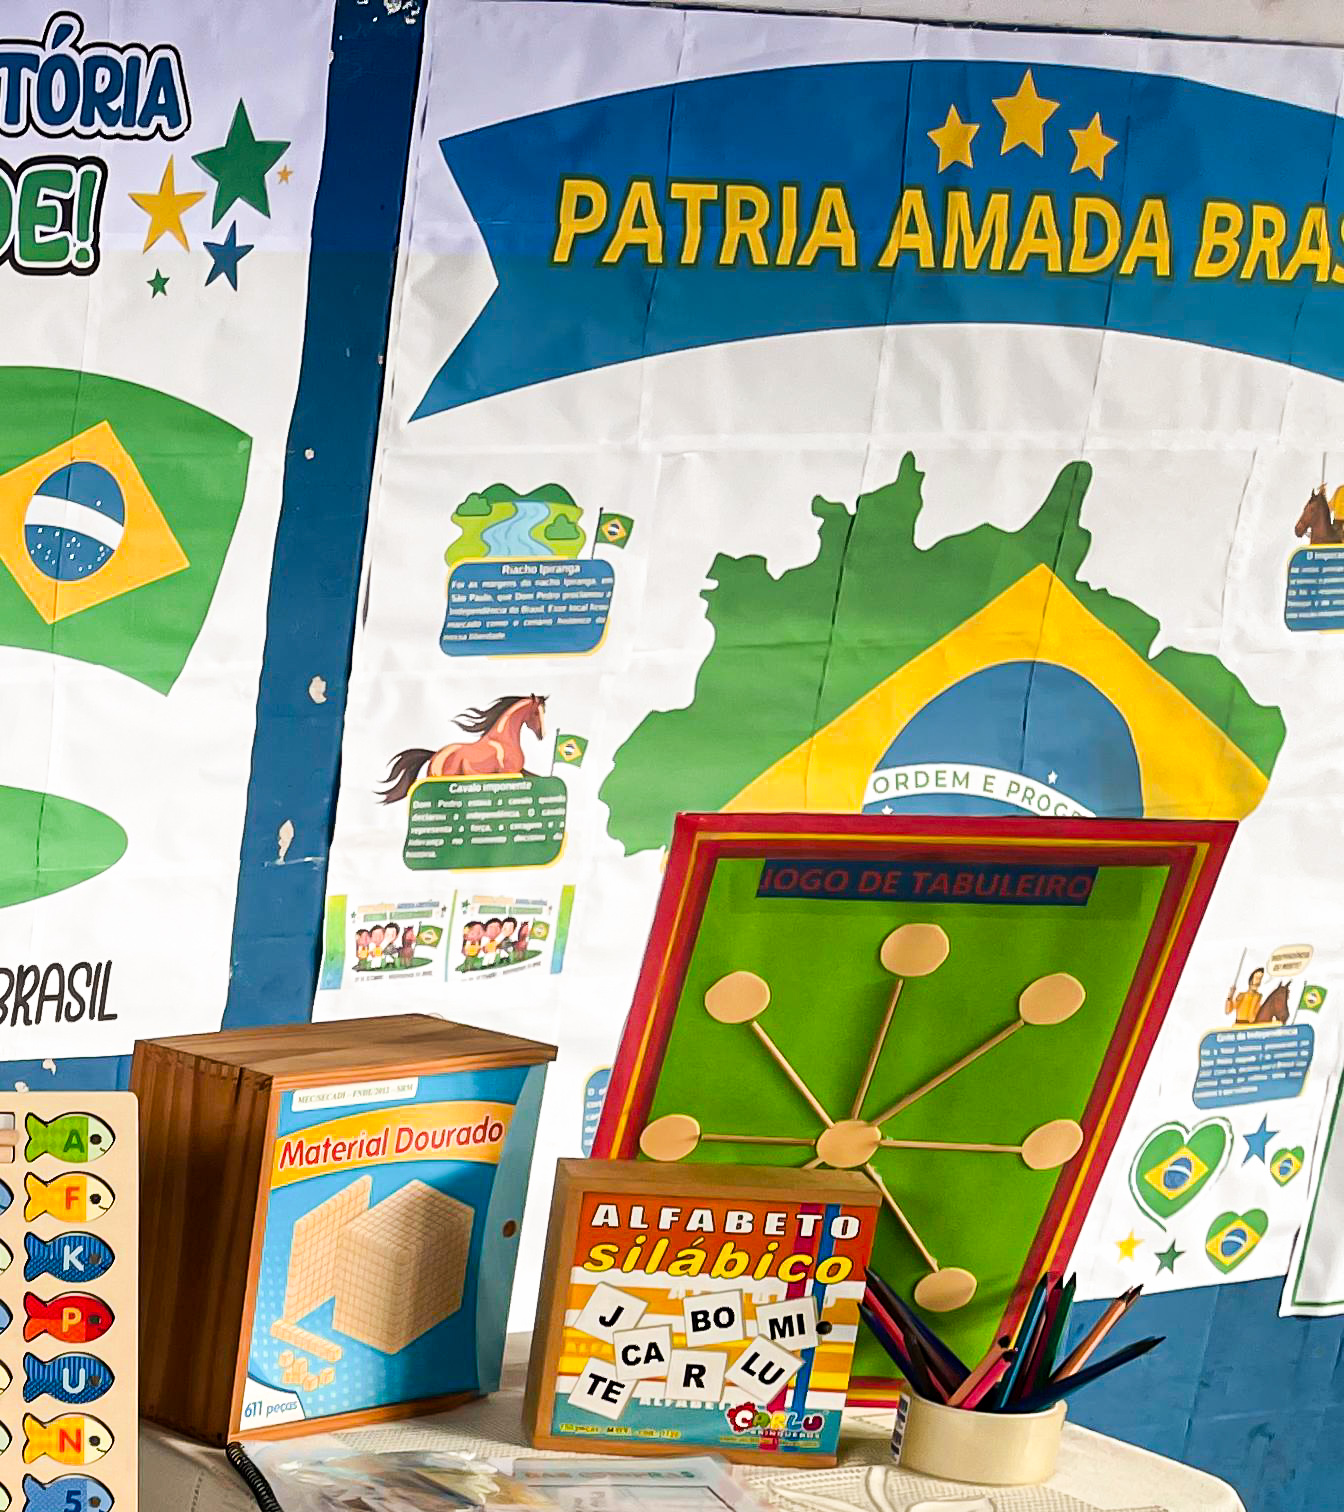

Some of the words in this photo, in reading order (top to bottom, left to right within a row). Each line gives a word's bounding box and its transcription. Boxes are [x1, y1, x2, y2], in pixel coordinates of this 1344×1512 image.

[551, 177, 857, 268] PATRIA
[875, 188, 1172, 279] AMADA
[873, 770, 970, 794] ORDEM
[983, 774, 994, 792] E
[763, 867, 850, 894] JOGO
[858, 870, 902, 894] DE
[912, 870, 1093, 899] TABULEIRO
[63, 1129, 86, 1153] A
[279, 1128, 390, 1171] Material
[394, 1115, 504, 1154] Dourado
[65, 1188, 80, 1211] F
[591, 1204, 860, 1240] ALFABETO
[63, 1246, 84, 1271] K
[583, 1235, 854, 1285] silábico
[62, 1307, 80, 1332] P
[599, 1305, 624, 1328] J
[690, 1307, 735, 1332] BO
[769, 1314, 806, 1340] MI
[621, 1341, 664, 1366] CA
[63, 1367, 84, 1392] U
[682, 1363, 706, 1389] R
[741, 1352, 785, 1385] LU
[588, 1372, 625, 1404] TE
[244, 1400, 264, 1418] 611
[59, 1428, 82, 1453] N
